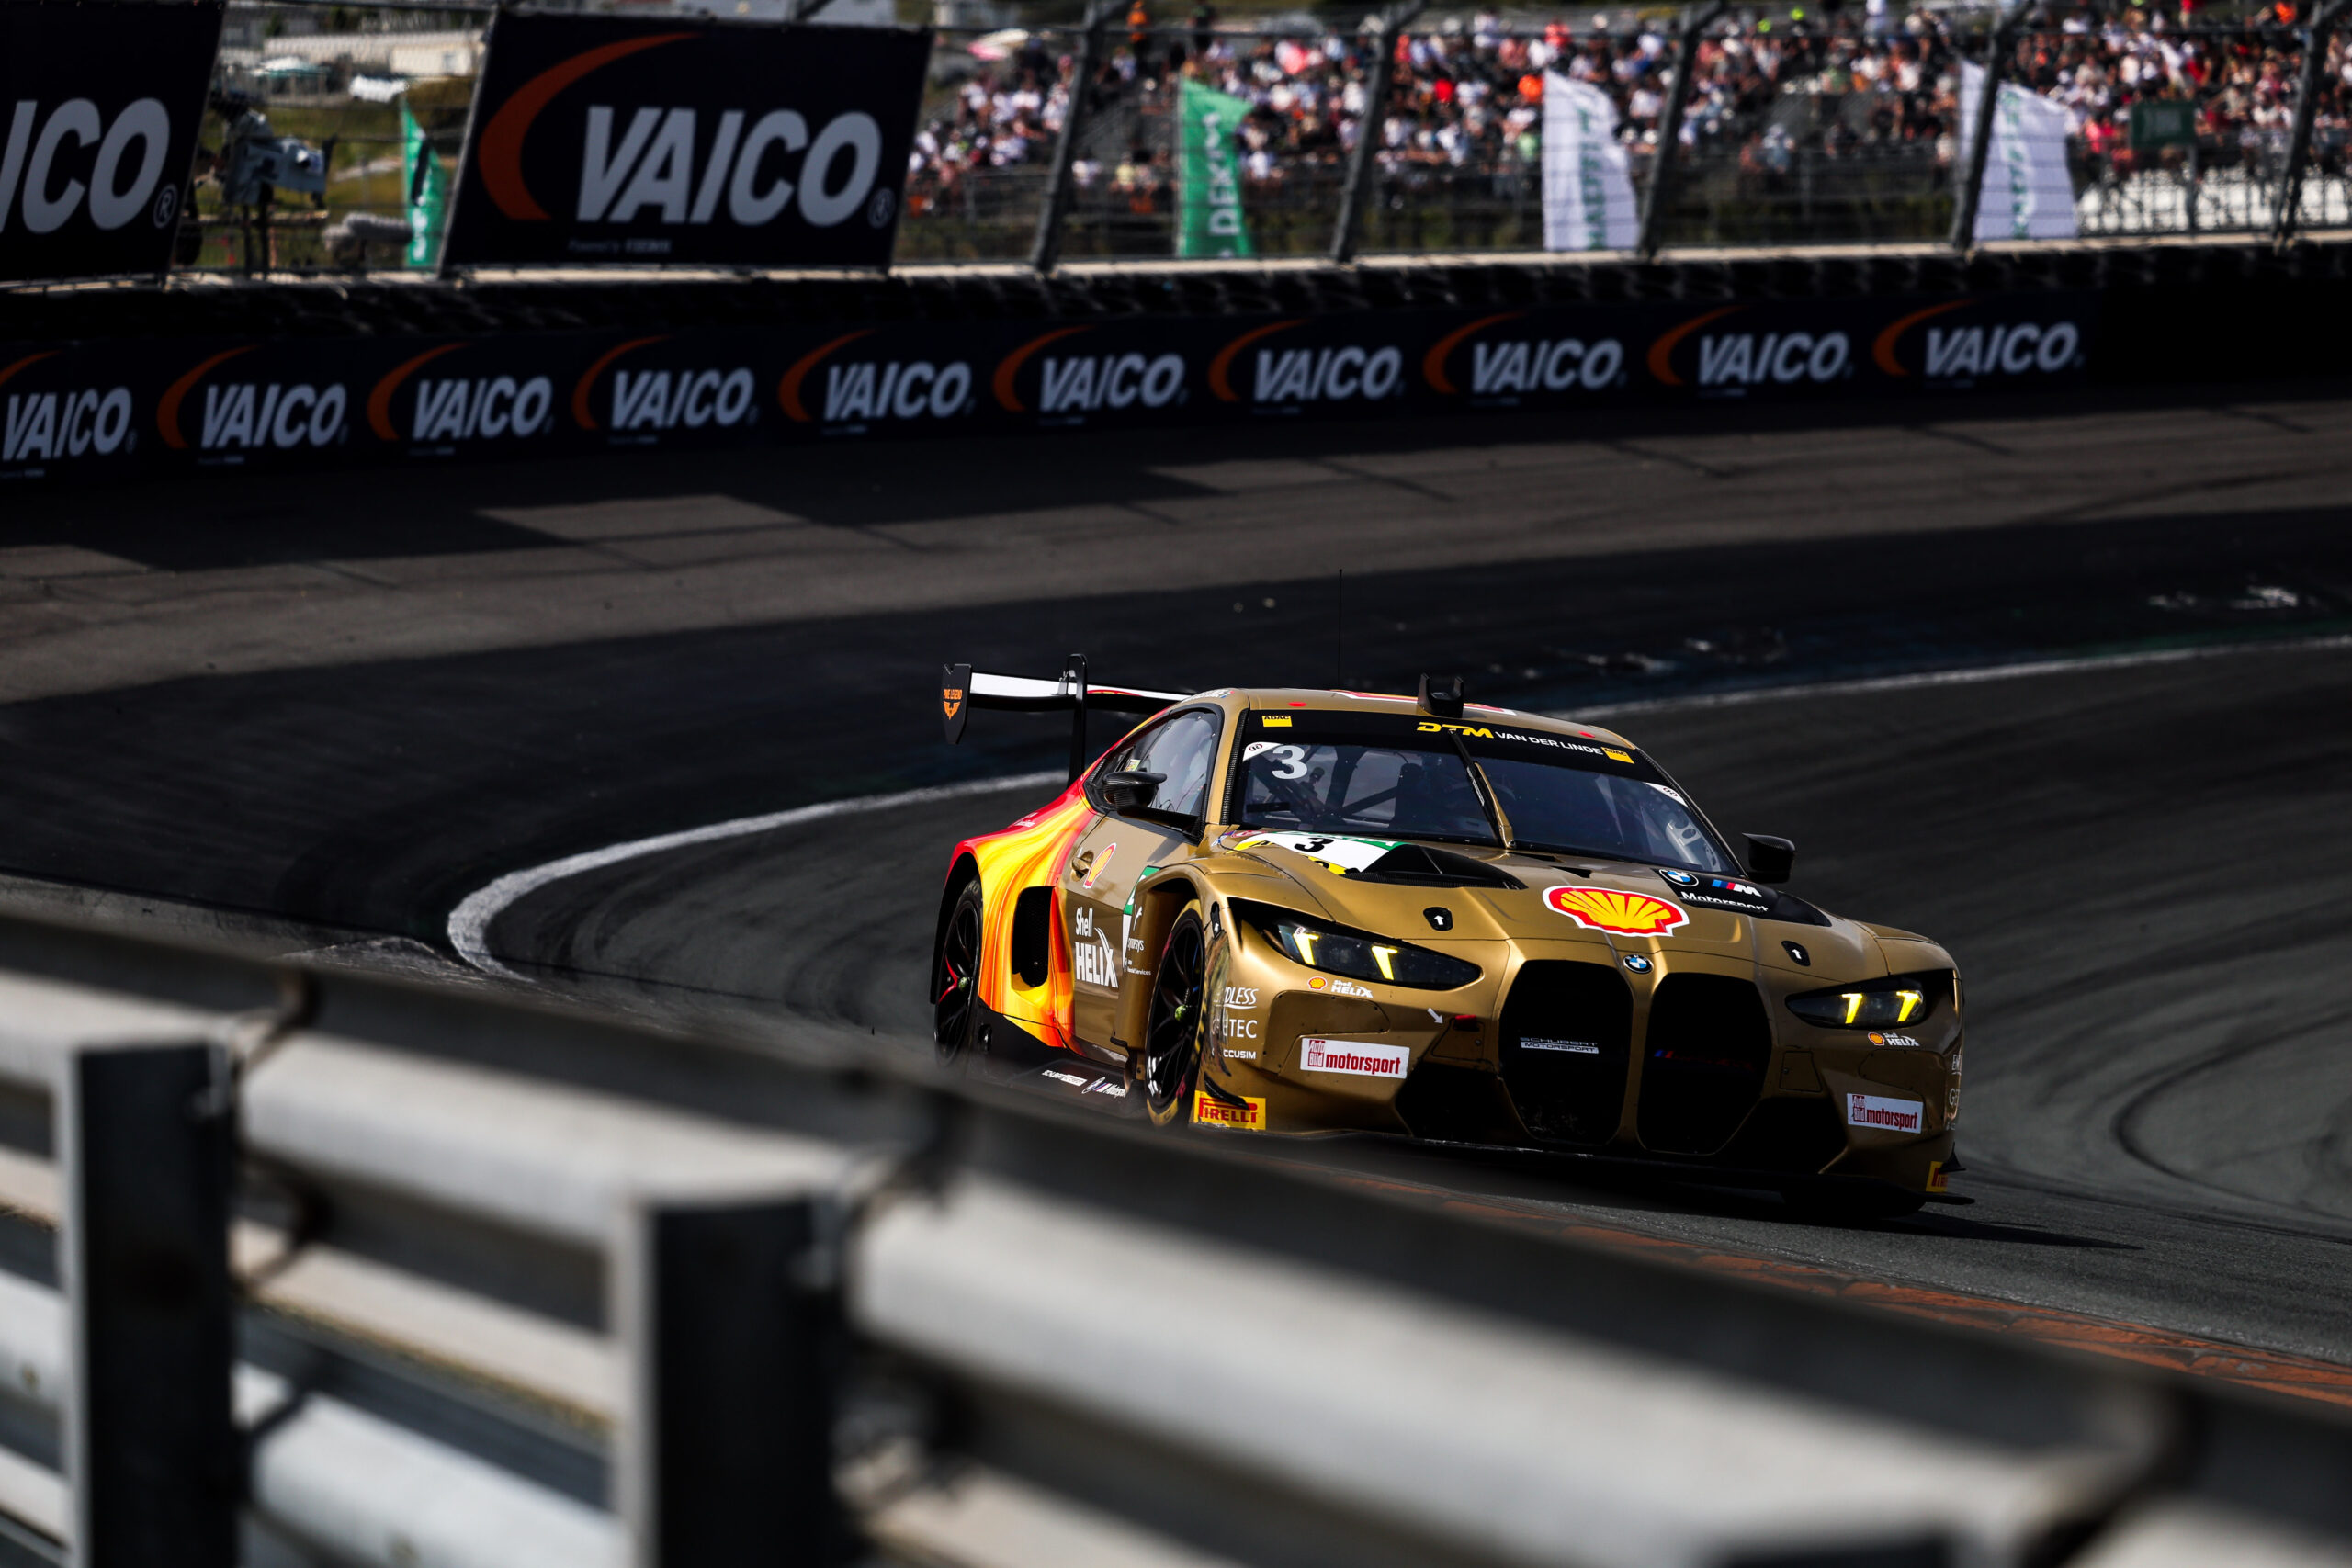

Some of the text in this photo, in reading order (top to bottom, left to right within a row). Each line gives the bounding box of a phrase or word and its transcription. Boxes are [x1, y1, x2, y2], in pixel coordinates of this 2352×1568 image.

[576, 106, 882, 227] VAICO
[1700, 333, 1849, 384] VAICO
[1928, 323, 2077, 373] VAICO
[1255, 346, 1401, 400] VAICO
[1473, 339, 1623, 391] VAICO
[612, 368, 753, 428] VAICO
[825, 362, 971, 420] VAICO
[1040, 353, 1185, 412] VAICO
[200, 384, 346, 448] VAICO
[413, 376, 552, 440] VAICO
[3, 387, 132, 461] VAICO
[1417, 721, 1494, 739] DTM
[1495, 731, 1604, 755] VAN DER LINDE
[1272, 745, 1308, 779] 3
[1294, 837, 1334, 852] 3
[1075, 906, 1093, 937] Shell
[1075, 927, 1118, 988] HELIX
[1331, 984, 1373, 998] HELIX
[1333, 979, 1352, 987] Shell
[1309, 1040, 1326, 1053] Auto
[1520, 1036, 1598, 1047] SCHUBERT
[1524, 1043, 1595, 1053] MOTORSPORT
[1886, 1036, 1919, 1047] HELIX
[1308, 1053, 1324, 1066] Bild
[1326, 1053, 1400, 1075] motorsport
[1199, 1097, 1258, 1123] PIRELLI
[1867, 1108, 1917, 1130] motorsport
